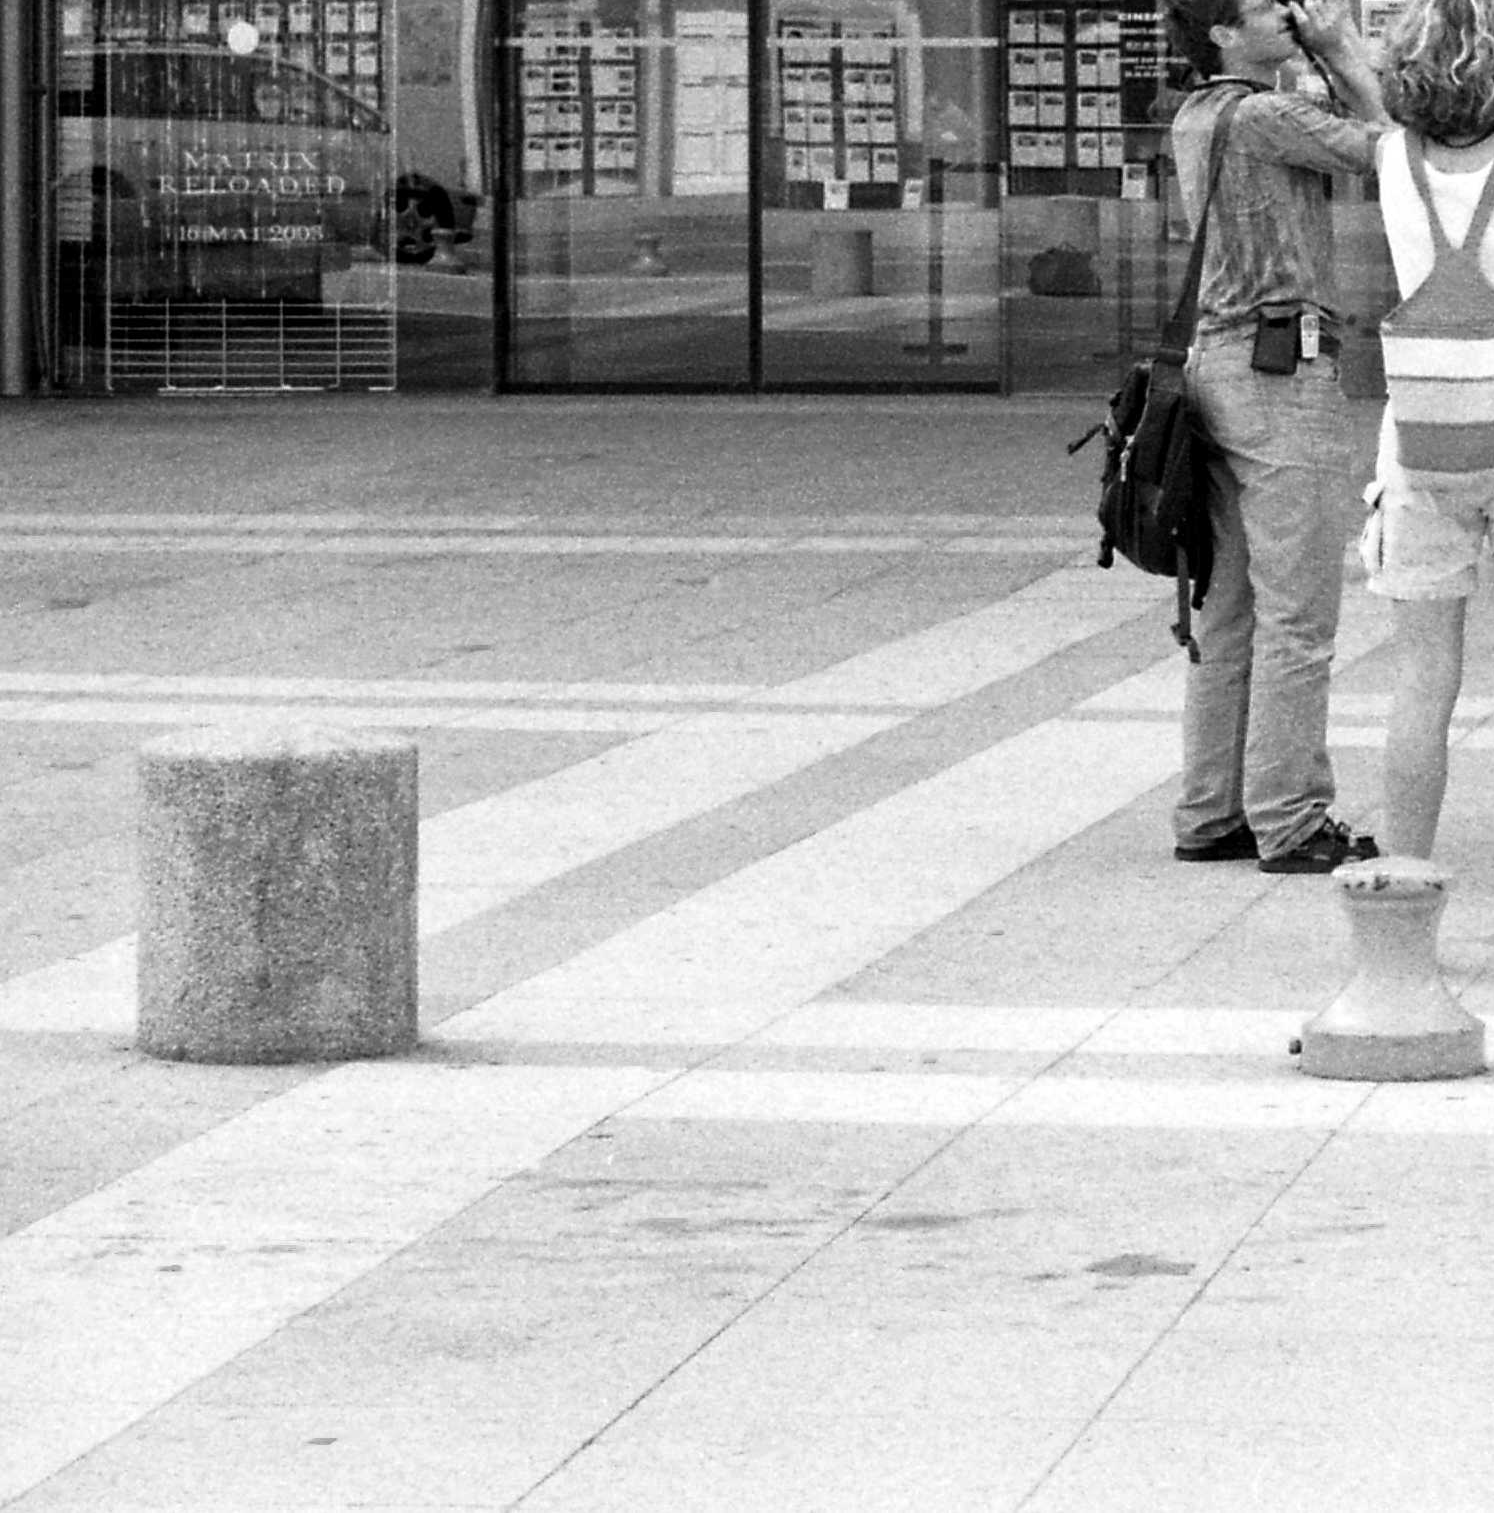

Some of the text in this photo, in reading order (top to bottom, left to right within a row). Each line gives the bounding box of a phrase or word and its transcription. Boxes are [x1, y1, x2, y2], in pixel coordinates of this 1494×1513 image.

[184, 151, 318, 171] MATRIX
[158, 174, 346, 195] RELOADED
[207, 224, 261, 242] MAI
